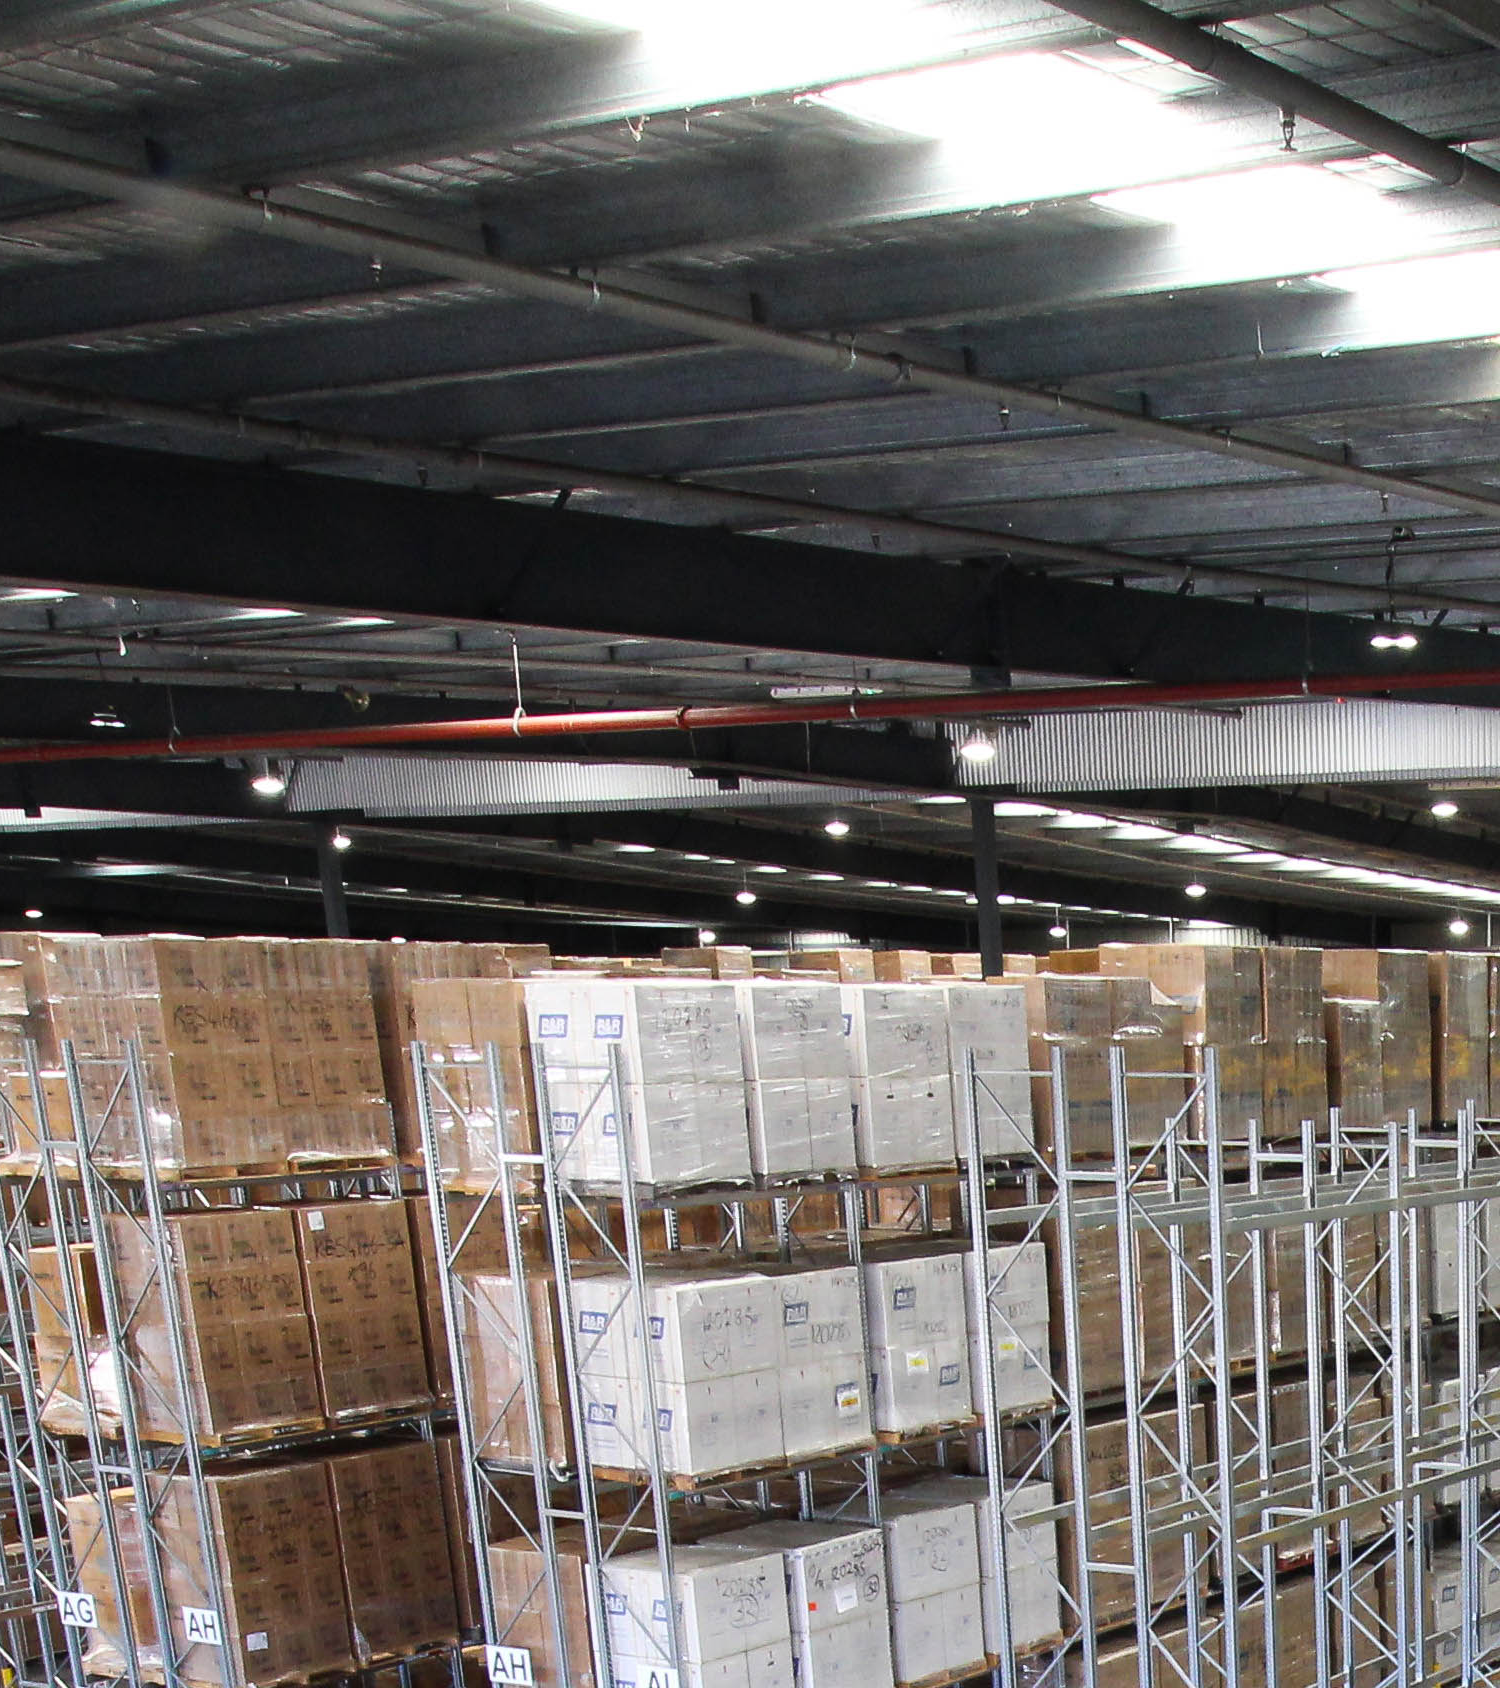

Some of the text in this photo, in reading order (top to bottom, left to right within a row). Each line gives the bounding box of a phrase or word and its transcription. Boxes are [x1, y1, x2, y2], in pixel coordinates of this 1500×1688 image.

[63, 1596, 93, 1623] AG
[188, 1612, 218, 1641] AH
[492, 1651, 528, 1682] AH
